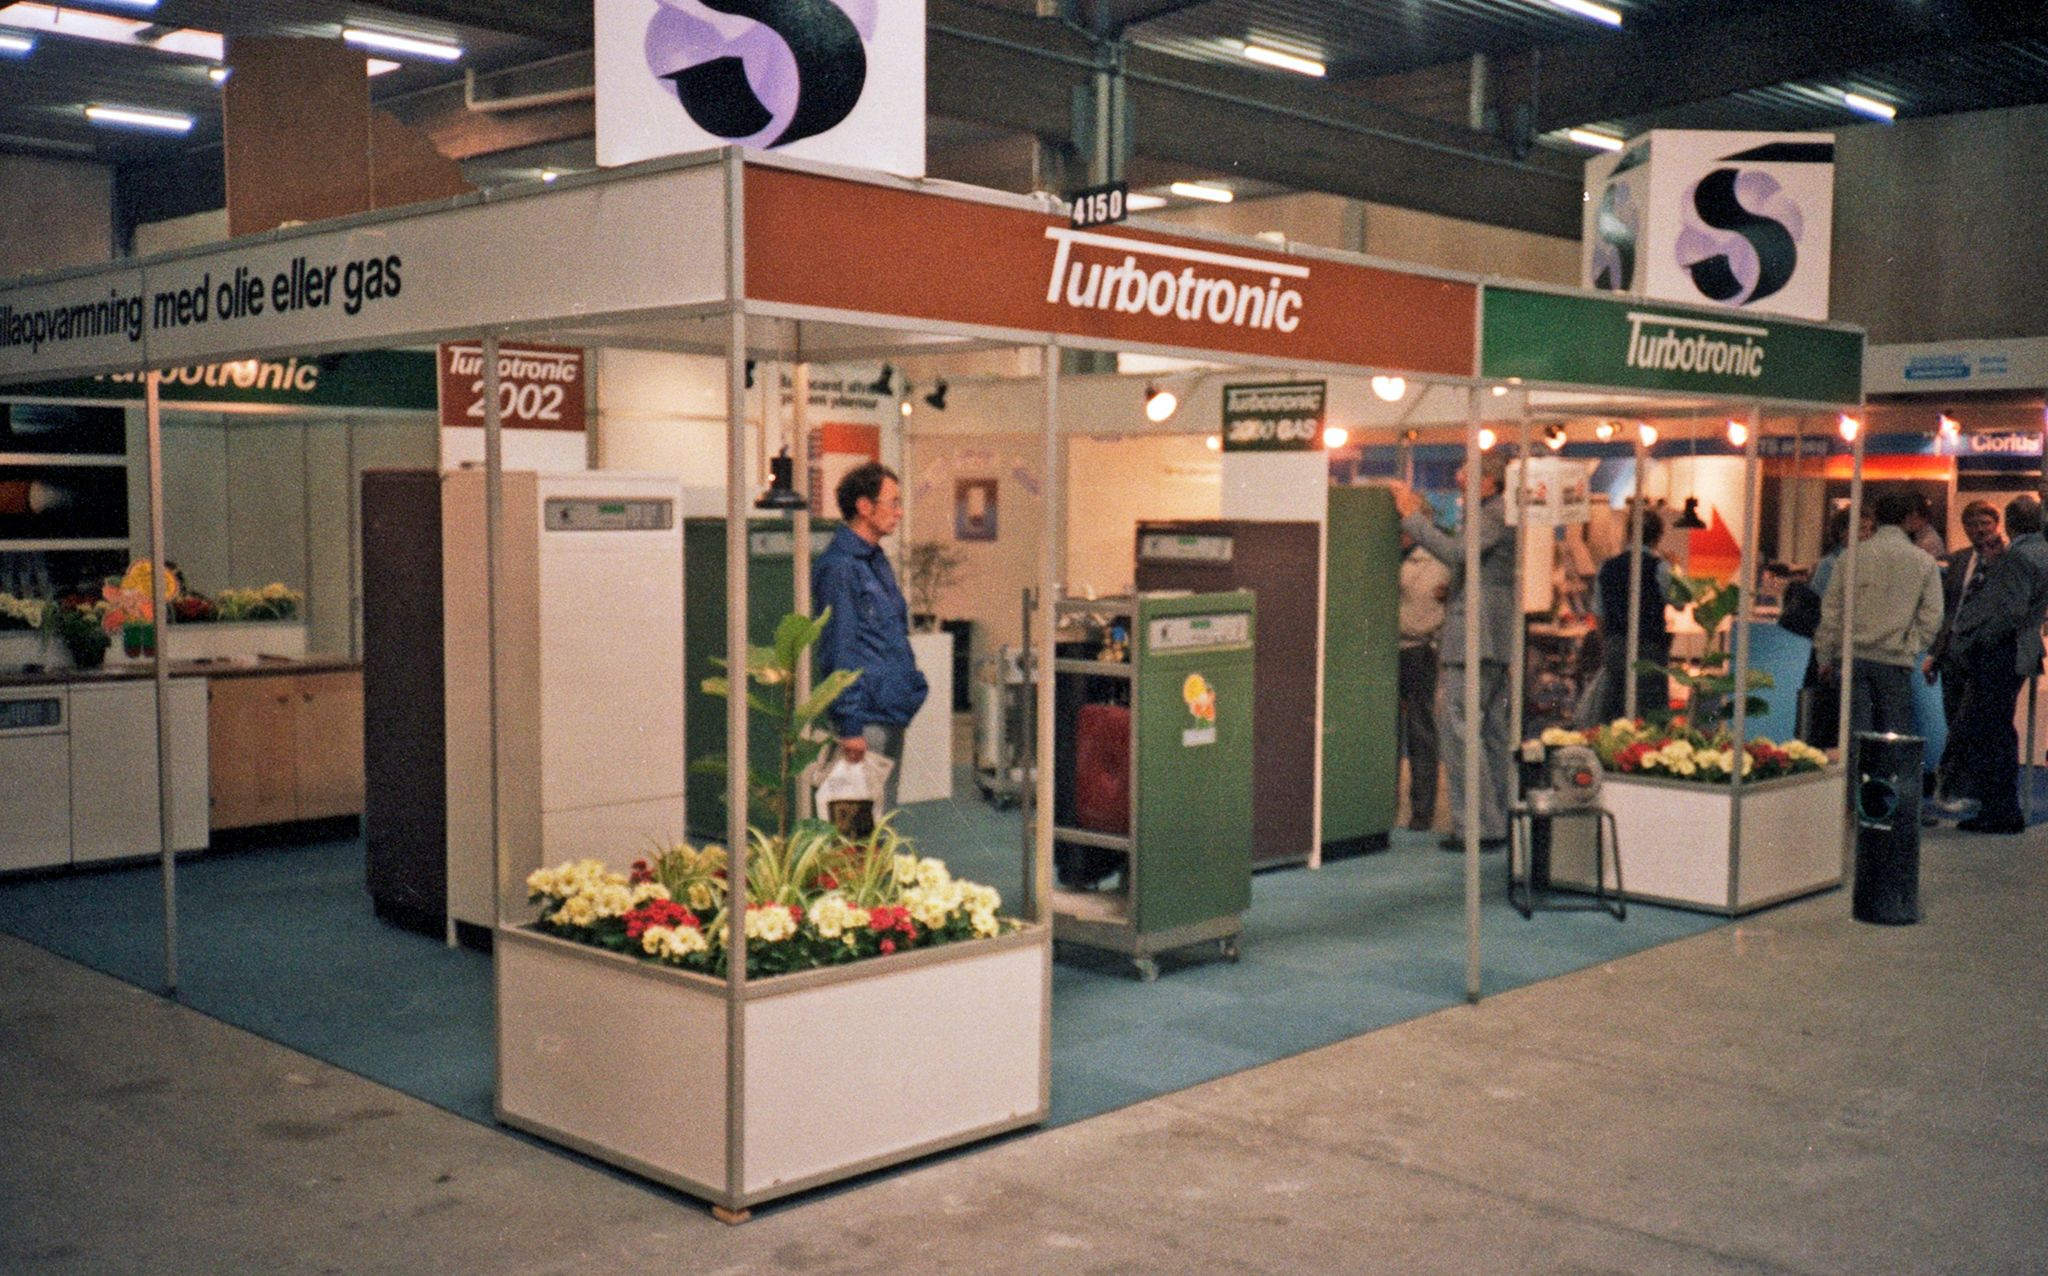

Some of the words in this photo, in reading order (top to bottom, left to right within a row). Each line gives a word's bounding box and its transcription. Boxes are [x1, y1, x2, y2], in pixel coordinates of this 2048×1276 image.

[1073, 190, 1122, 225] 4150
[153, 272, 210, 329] med
[216, 266, 265, 320] olie
[271, 257, 337, 312] eller
[343, 254, 402, 316] gas
[1045, 226, 1310, 333] Turbotronic
[448, 346, 581, 382] Turotronic
[1627, 311, 1769, 377] Turbotronic
[466, 378, 564, 419] 2002
